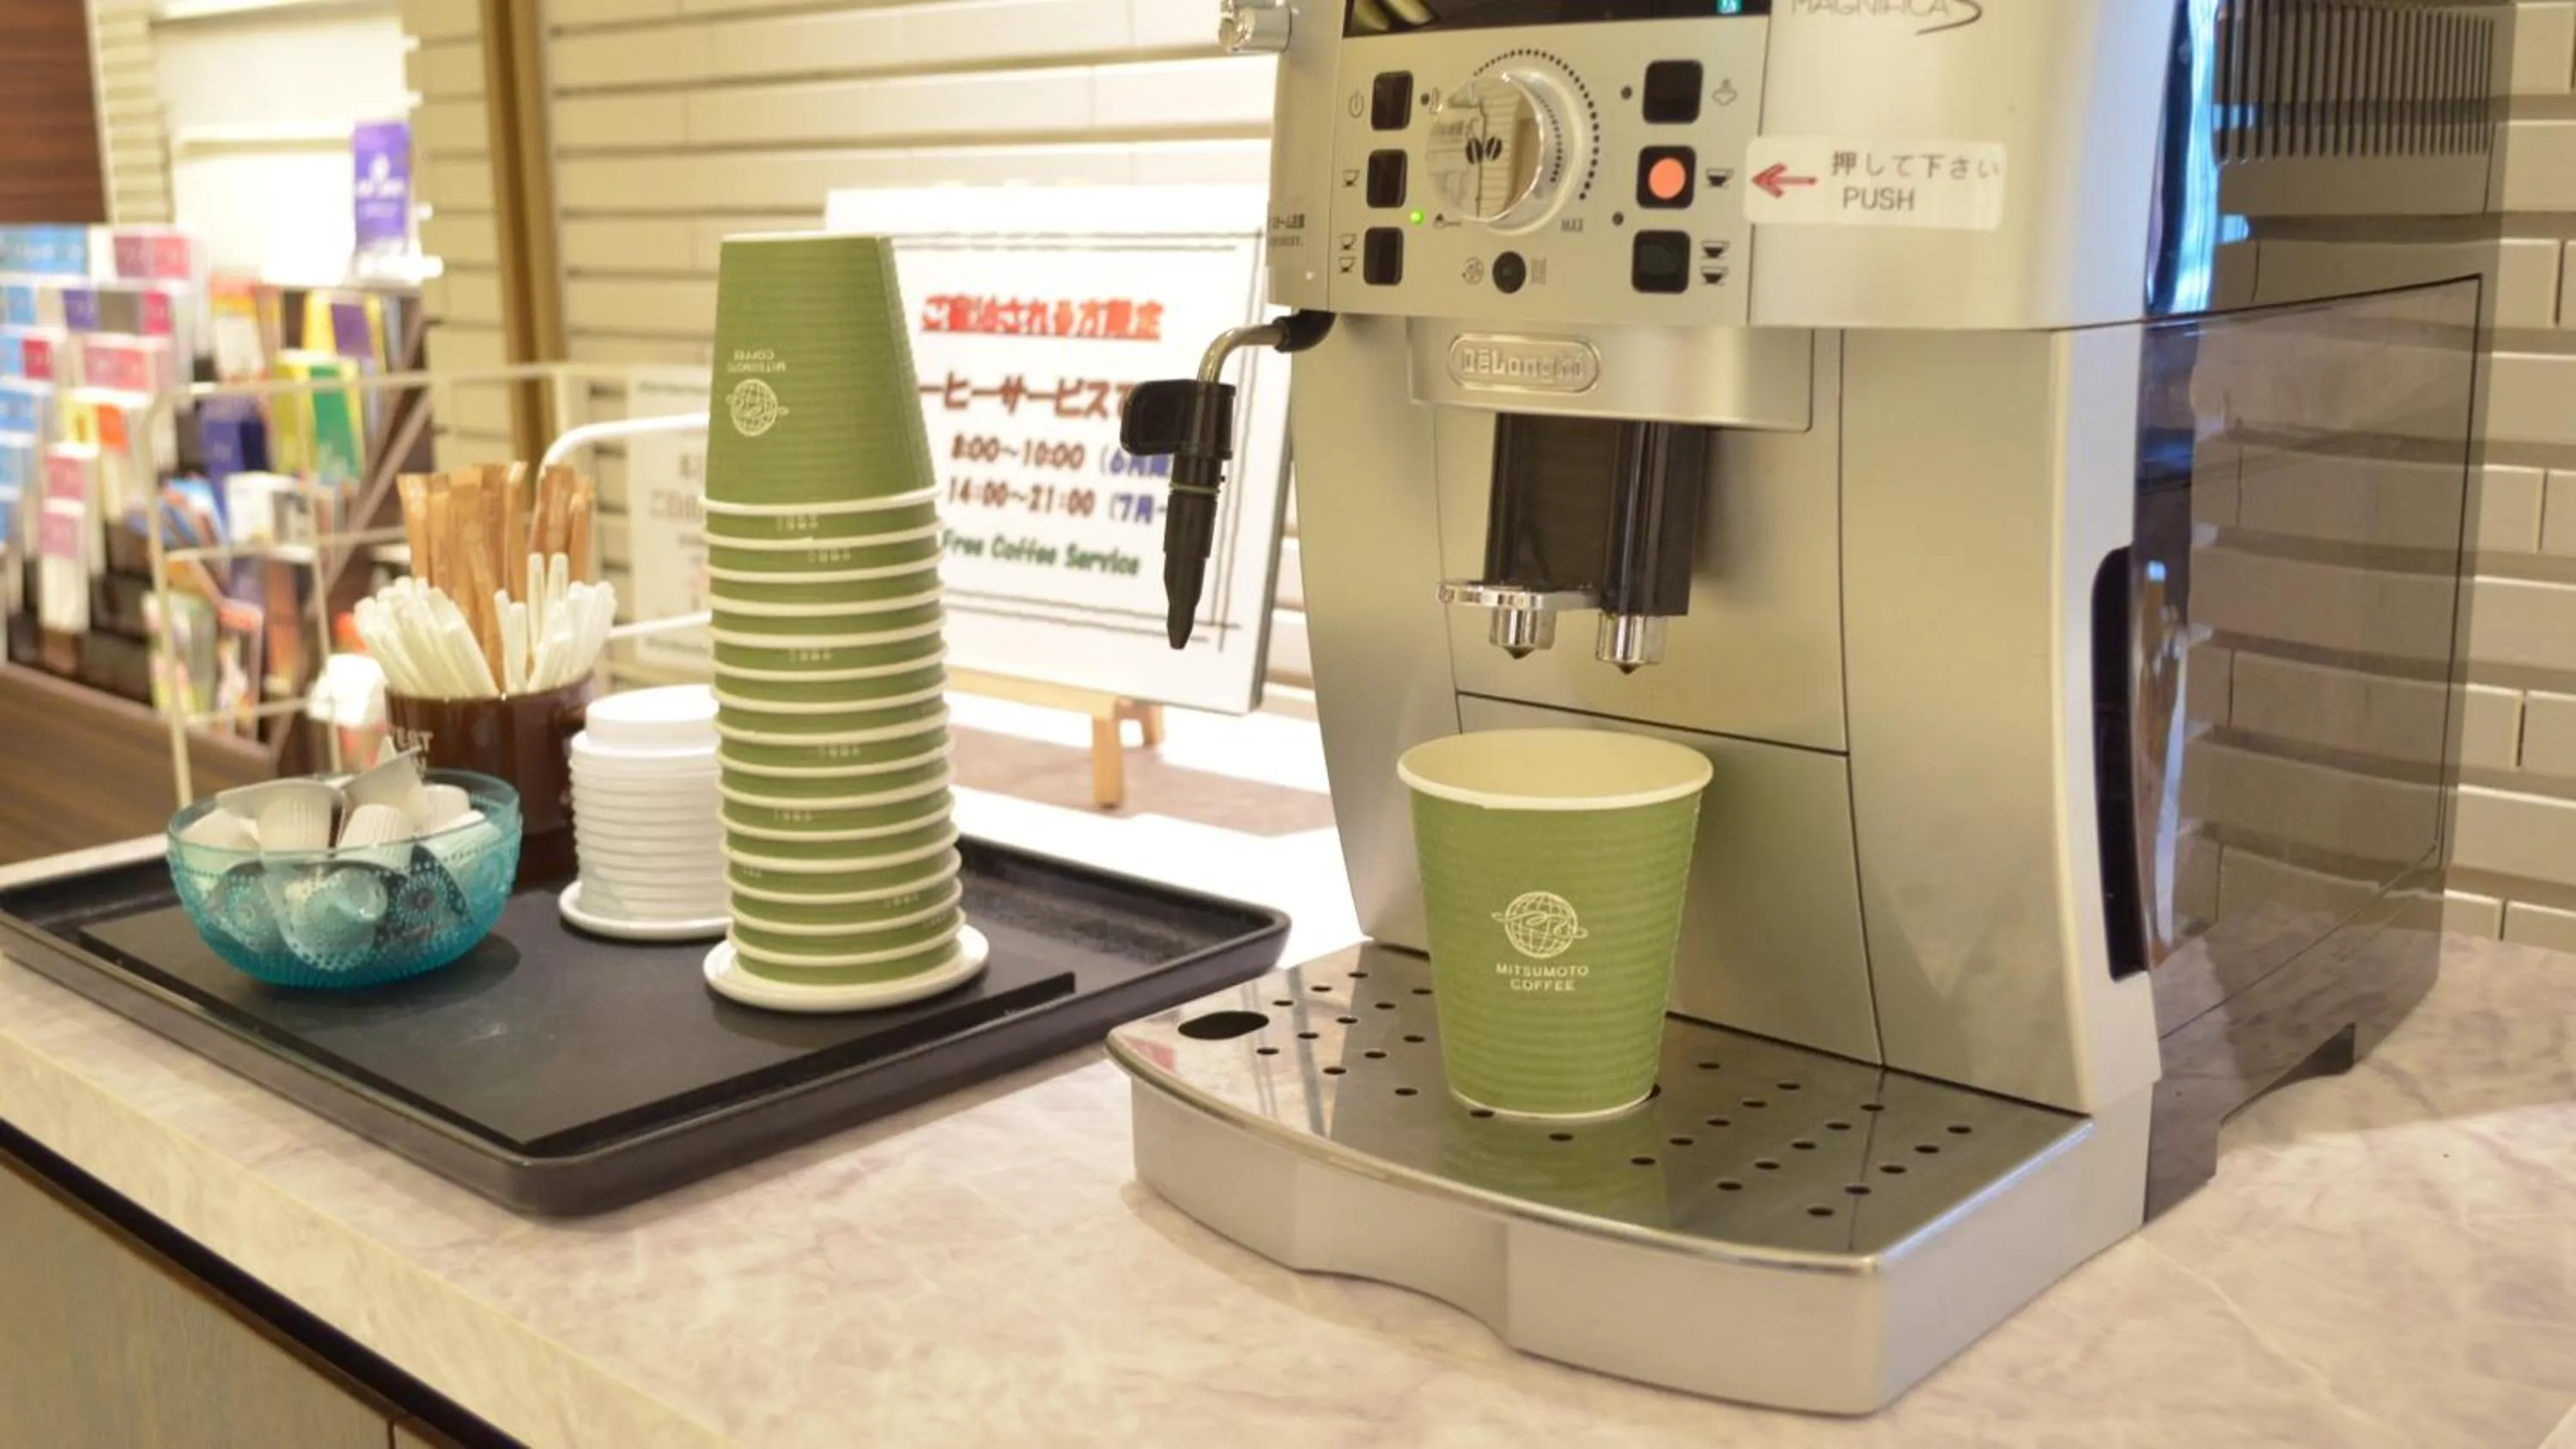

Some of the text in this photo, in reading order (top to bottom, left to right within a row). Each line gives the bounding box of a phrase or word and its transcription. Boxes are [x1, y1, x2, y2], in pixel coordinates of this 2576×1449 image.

[1831, 149, 2001, 180] 押して下さい
[1842, 185, 1916, 212] PUSH
[1560, 218, 1584, 234] MAX
[943, 528, 1140, 576] Free Coffee Service
[1495, 962, 1589, 978] MITSUMOTO
[1510, 978, 1576, 992] COFFEE
